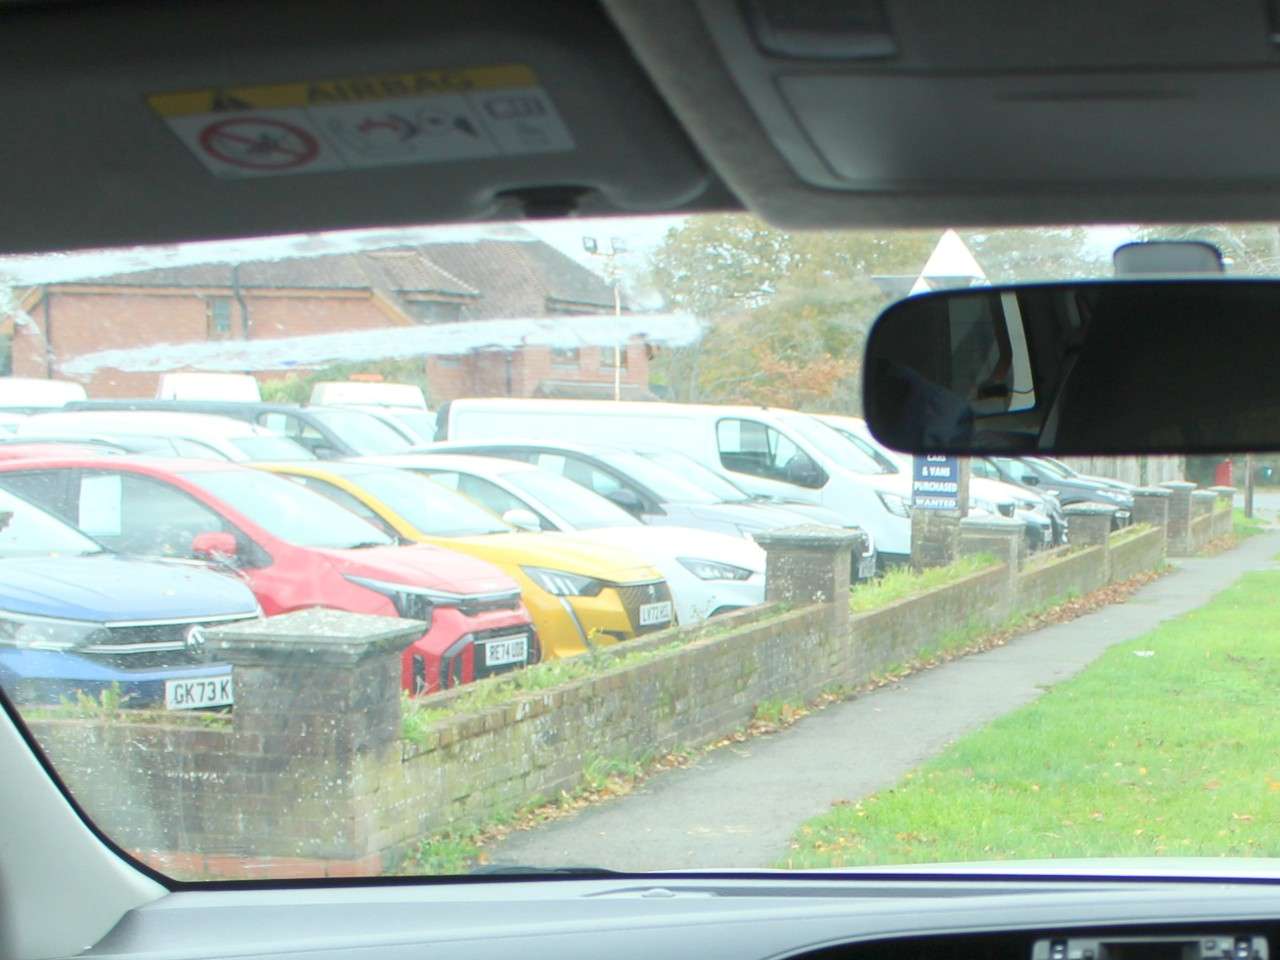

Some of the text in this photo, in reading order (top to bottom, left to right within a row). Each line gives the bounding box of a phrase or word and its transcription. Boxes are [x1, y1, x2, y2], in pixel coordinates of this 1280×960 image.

[307, 76, 475, 103] AIRBAG
[930, 467, 950, 477] VANS
[914, 482, 957, 492] PURCHASED
[174, 680, 230, 704] GK73 K
